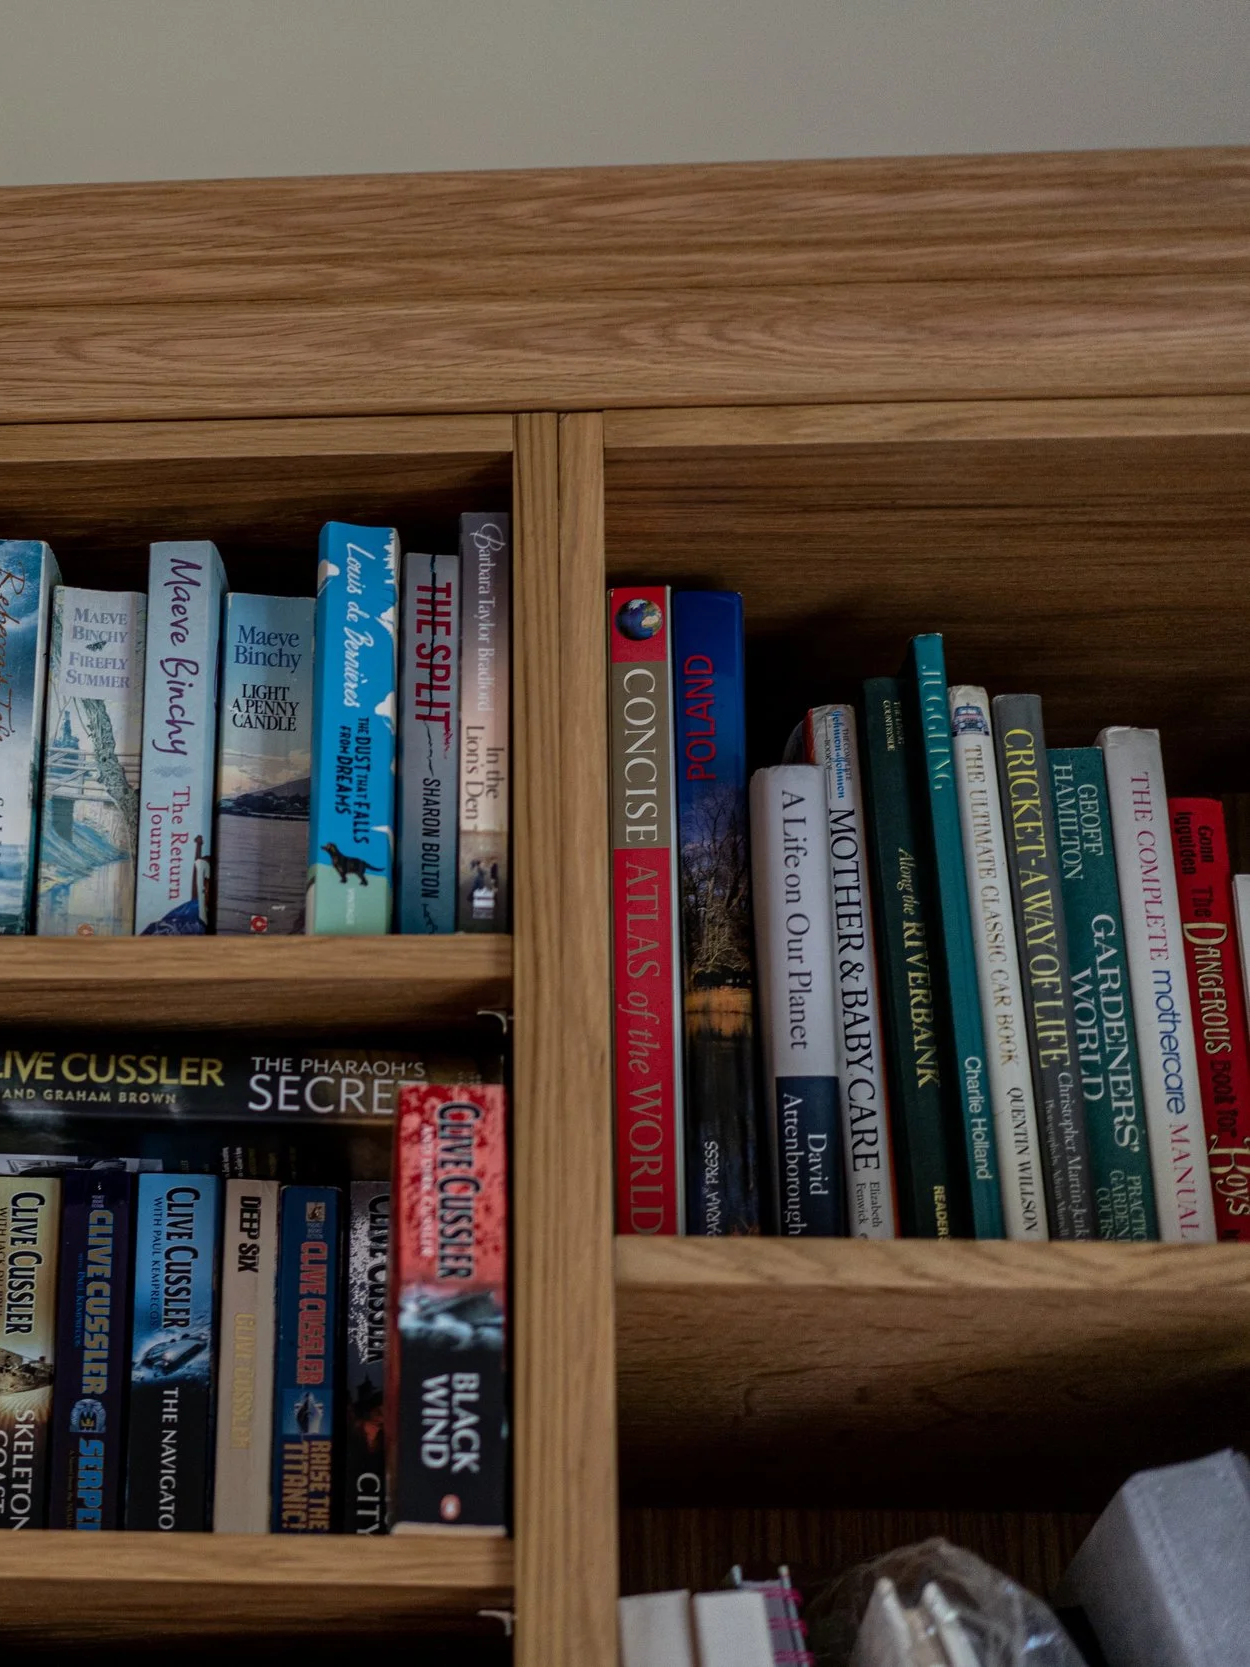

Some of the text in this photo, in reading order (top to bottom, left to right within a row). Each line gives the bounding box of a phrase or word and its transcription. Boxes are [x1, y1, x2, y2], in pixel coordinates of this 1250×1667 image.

[469, 523, 506, 595] Barbara
[238, 625, 300, 648] Maeve
[416, 582, 452, 636] THE
[152, 558, 202, 756] Maeve Binchy
[233, 645, 302, 674] Binchy
[242, 683, 290, 701] LIGHT
[232, 714, 297, 732] CANDLE
[245, 699, 299, 717] PENNY
[339, 726, 352, 755] FROM
[684, 655, 717, 781] POLAND
[353, 717, 372, 845] THE DUST THAT FALLS
[1053, 764, 1084, 880] HAMILTON
[1078, 784, 1104, 856] GEOFF
[142, 802, 169, 882] Journey
[168, 786, 190, 900] The Return
[421, 777, 440, 900] SHARON BOLTON
[624, 668, 660, 1074] CONCISE ATLAS the
[964, 745, 1012, 1008] THE ULTIMATE CLASSIC CAR
[1131, 771, 1169, 961] THE COMPLETE
[783, 816, 812, 1050] Life on Our Planet
[829, 808, 874, 1075] MOTHER BABY
[1029, 954, 1070, 1068] OF LIFE
[1070, 968, 1105, 1101] WORLD
[1152, 970, 1187, 1115] mothercare
[3, 1088, 176, 1104] AND GRAHAM BROWN
[61, 1052, 225, 1086] CUSSLER
[251, 1057, 293, 1072] THE
[783, 1093, 808, 1236] Attenborough
[808, 1133, 829, 1195] David
[848, 1078, 880, 1172] CARE
[965, 1056, 993, 1180] Charlie Holland
[1007, 1087, 1038, 1232] QUENTIN WILLSON
[166, 1187, 200, 1241] CLIVE
[438, 1101, 482, 1279] CLIVE CUSSLER
[856, 1182, 867, 1225] Fenwick
[870, 1181, 883, 1228] Elizabeth
[1169, 1124, 1200, 1238] MANUAL
[5, 1191, 46, 1335] CLIVE CUSSLER
[87, 1210, 113, 1279] CLIVE
[150, 1197, 163, 1325] WITH PAUL KEMPRECOS
[238, 1196, 262, 1273] DEEP SIX
[300, 1241, 328, 1295] CLIVE
[163, 1245, 198, 1329] CUSSLER
[82, 1281, 111, 1394] CUSSLER
[162, 1387, 179, 1423] THE
[421, 1374, 450, 1469] WIND
[452, 1372, 481, 1474] BLACK
